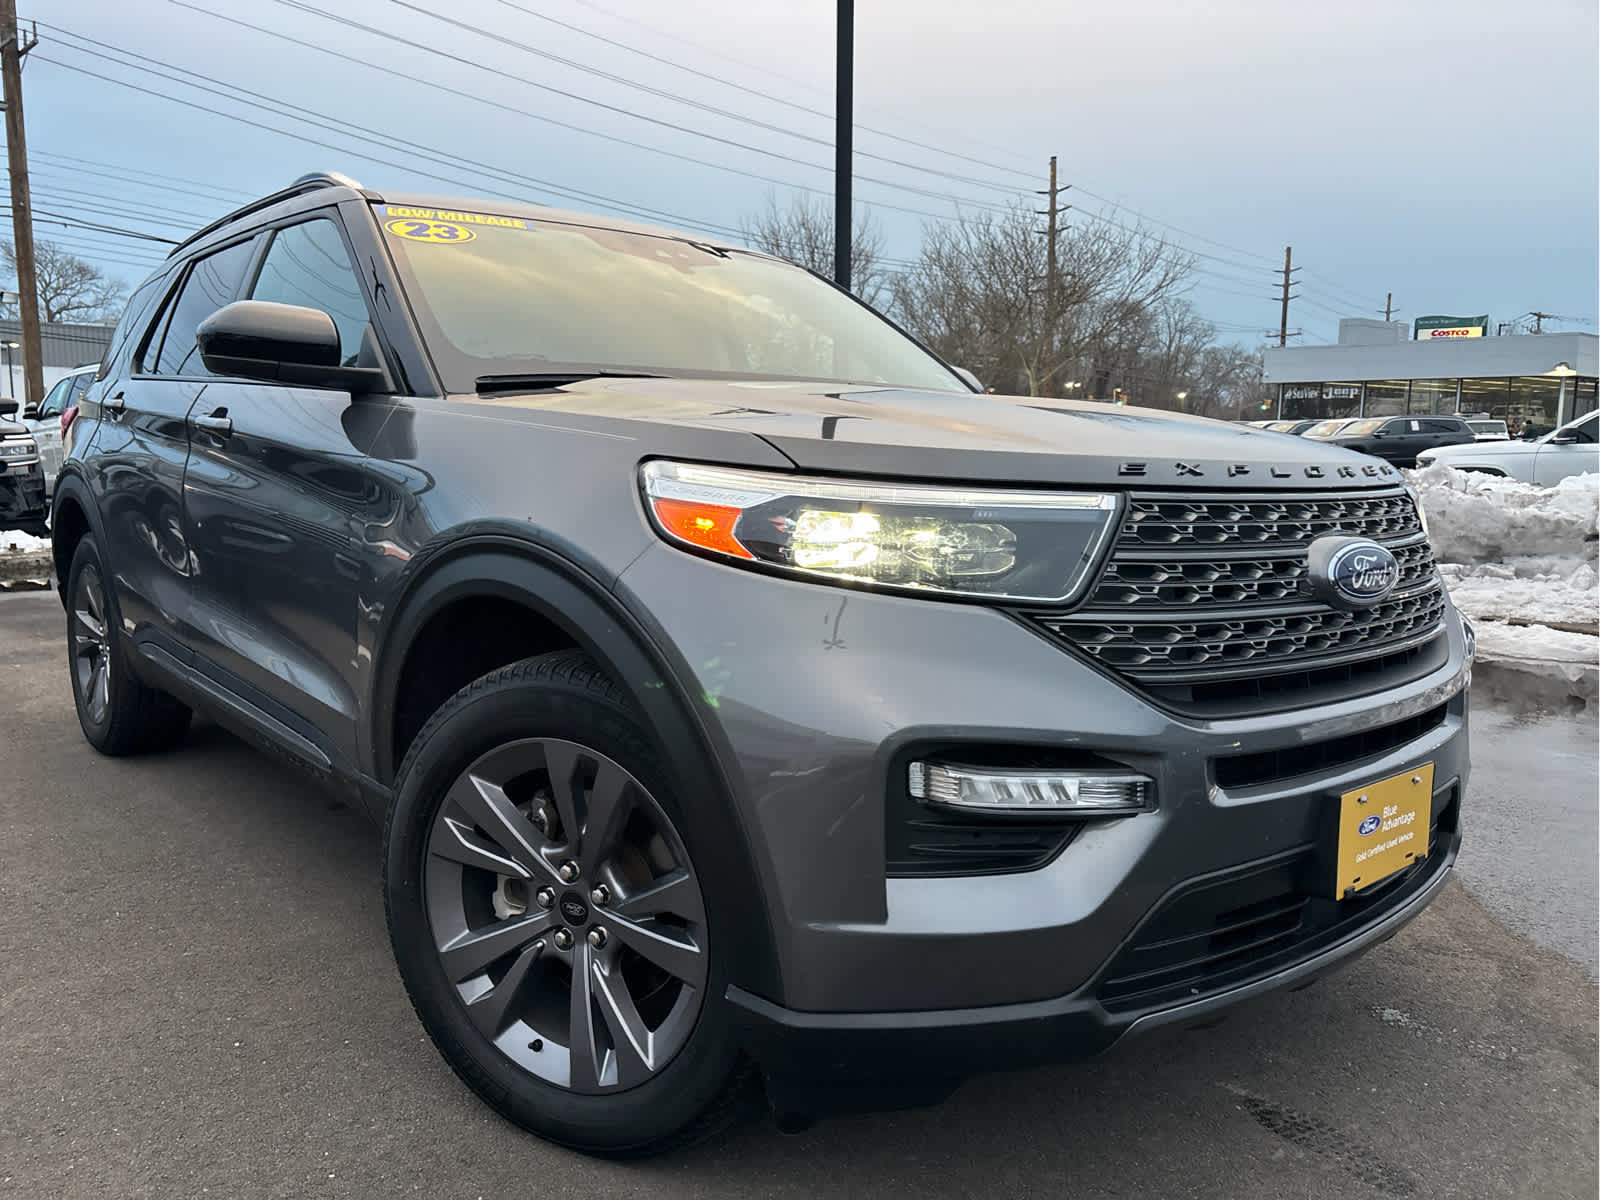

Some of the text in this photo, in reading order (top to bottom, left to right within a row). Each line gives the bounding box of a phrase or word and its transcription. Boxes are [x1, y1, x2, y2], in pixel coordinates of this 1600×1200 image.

[386, 206, 529, 230] LOW MILEAGE
[405, 222, 459, 239] 23
[1431, 329, 1469, 337] COSTCO
[1322, 386, 1359, 399] Jeep
[1118, 462, 1393, 480] EXPLORER
[1352, 555, 1388, 589] Ford
[1383, 805, 1397, 818] Blue
[1381, 811, 1415, 832] Advantage
